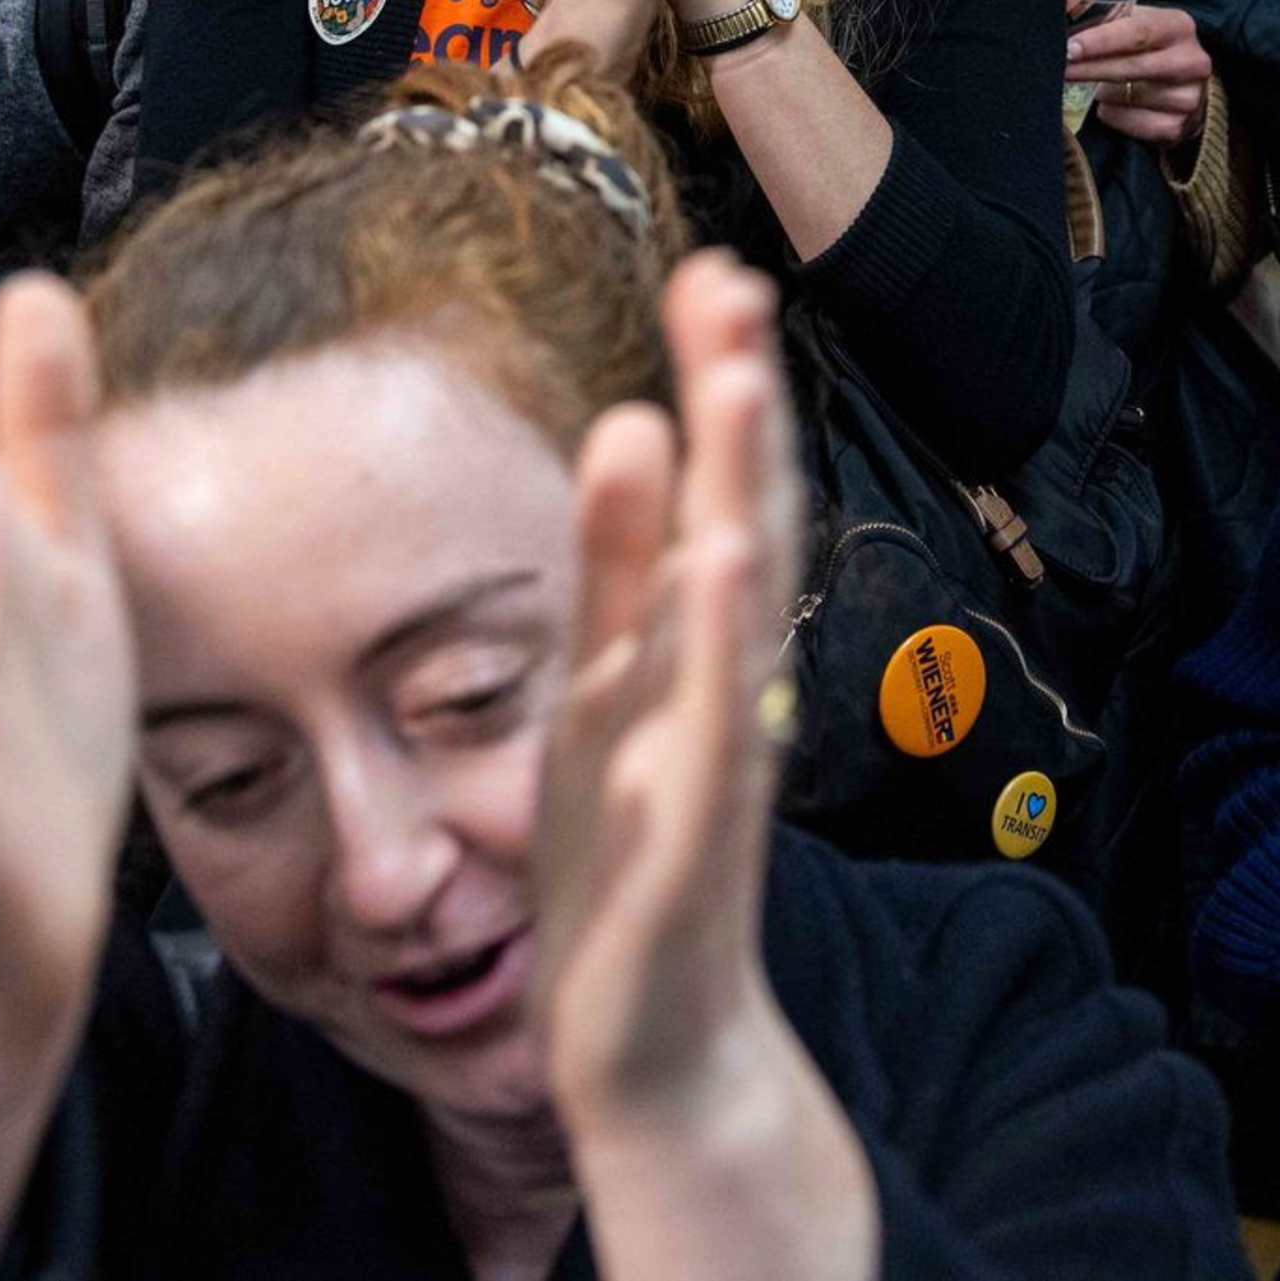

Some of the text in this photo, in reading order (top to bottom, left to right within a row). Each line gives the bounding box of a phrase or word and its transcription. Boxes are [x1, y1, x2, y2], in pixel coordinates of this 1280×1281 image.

[916, 637, 954, 738] WIENER
[940, 651, 956, 691] Scott
[1016, 792, 1025, 815] I
[1001, 815, 1047, 843] TRANSIT
